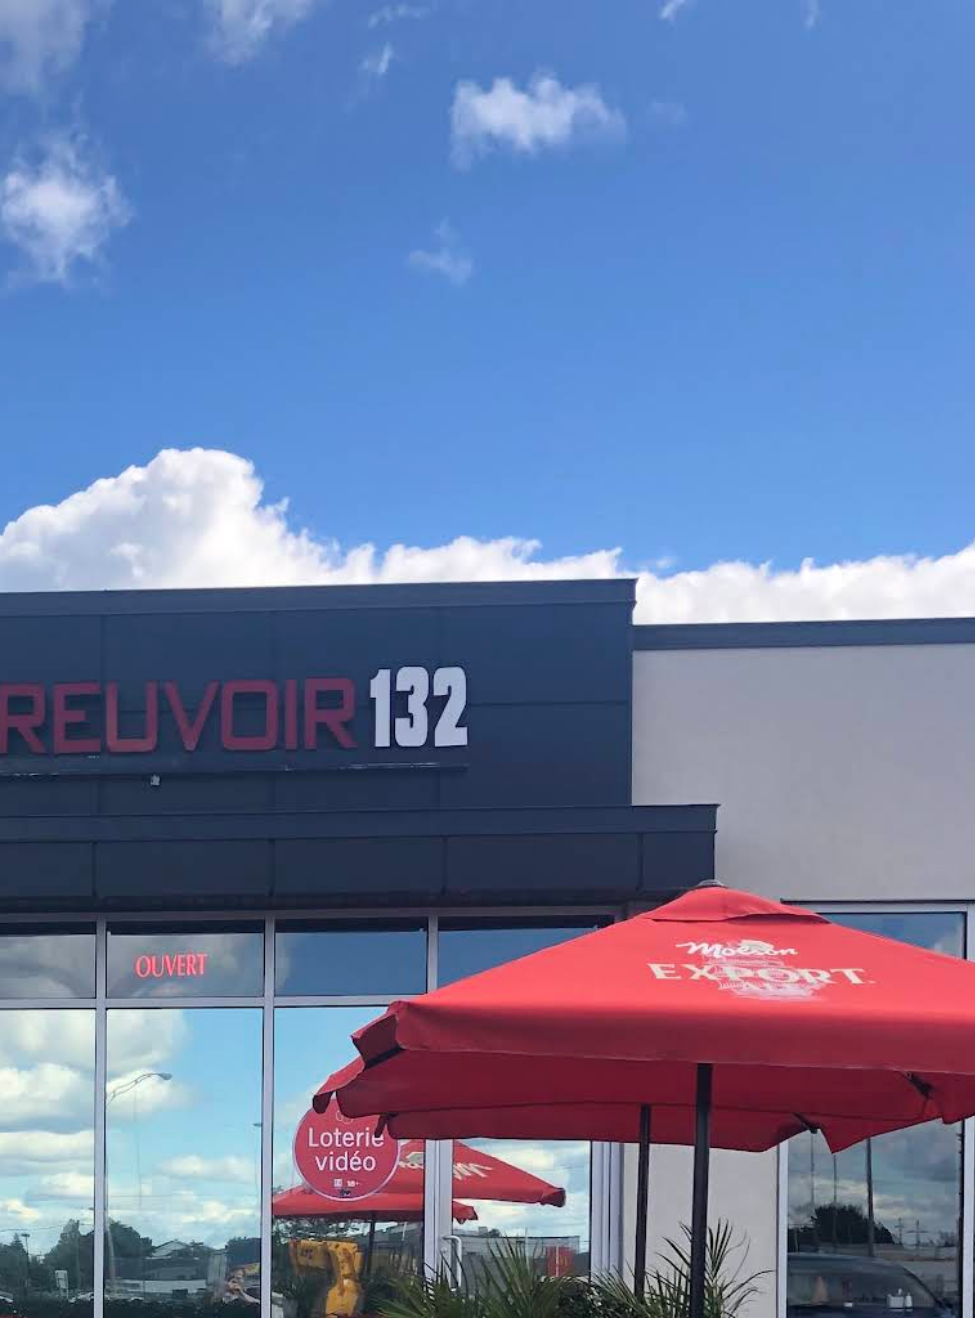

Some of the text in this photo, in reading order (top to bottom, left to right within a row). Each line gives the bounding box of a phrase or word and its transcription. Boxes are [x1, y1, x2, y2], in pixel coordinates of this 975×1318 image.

[370, 666, 468, 748] 132
[135, 953, 208, 977] OUVERT
[308, 1127, 385, 1147] Loterie
[315, 1151, 376, 1171] vidéo
